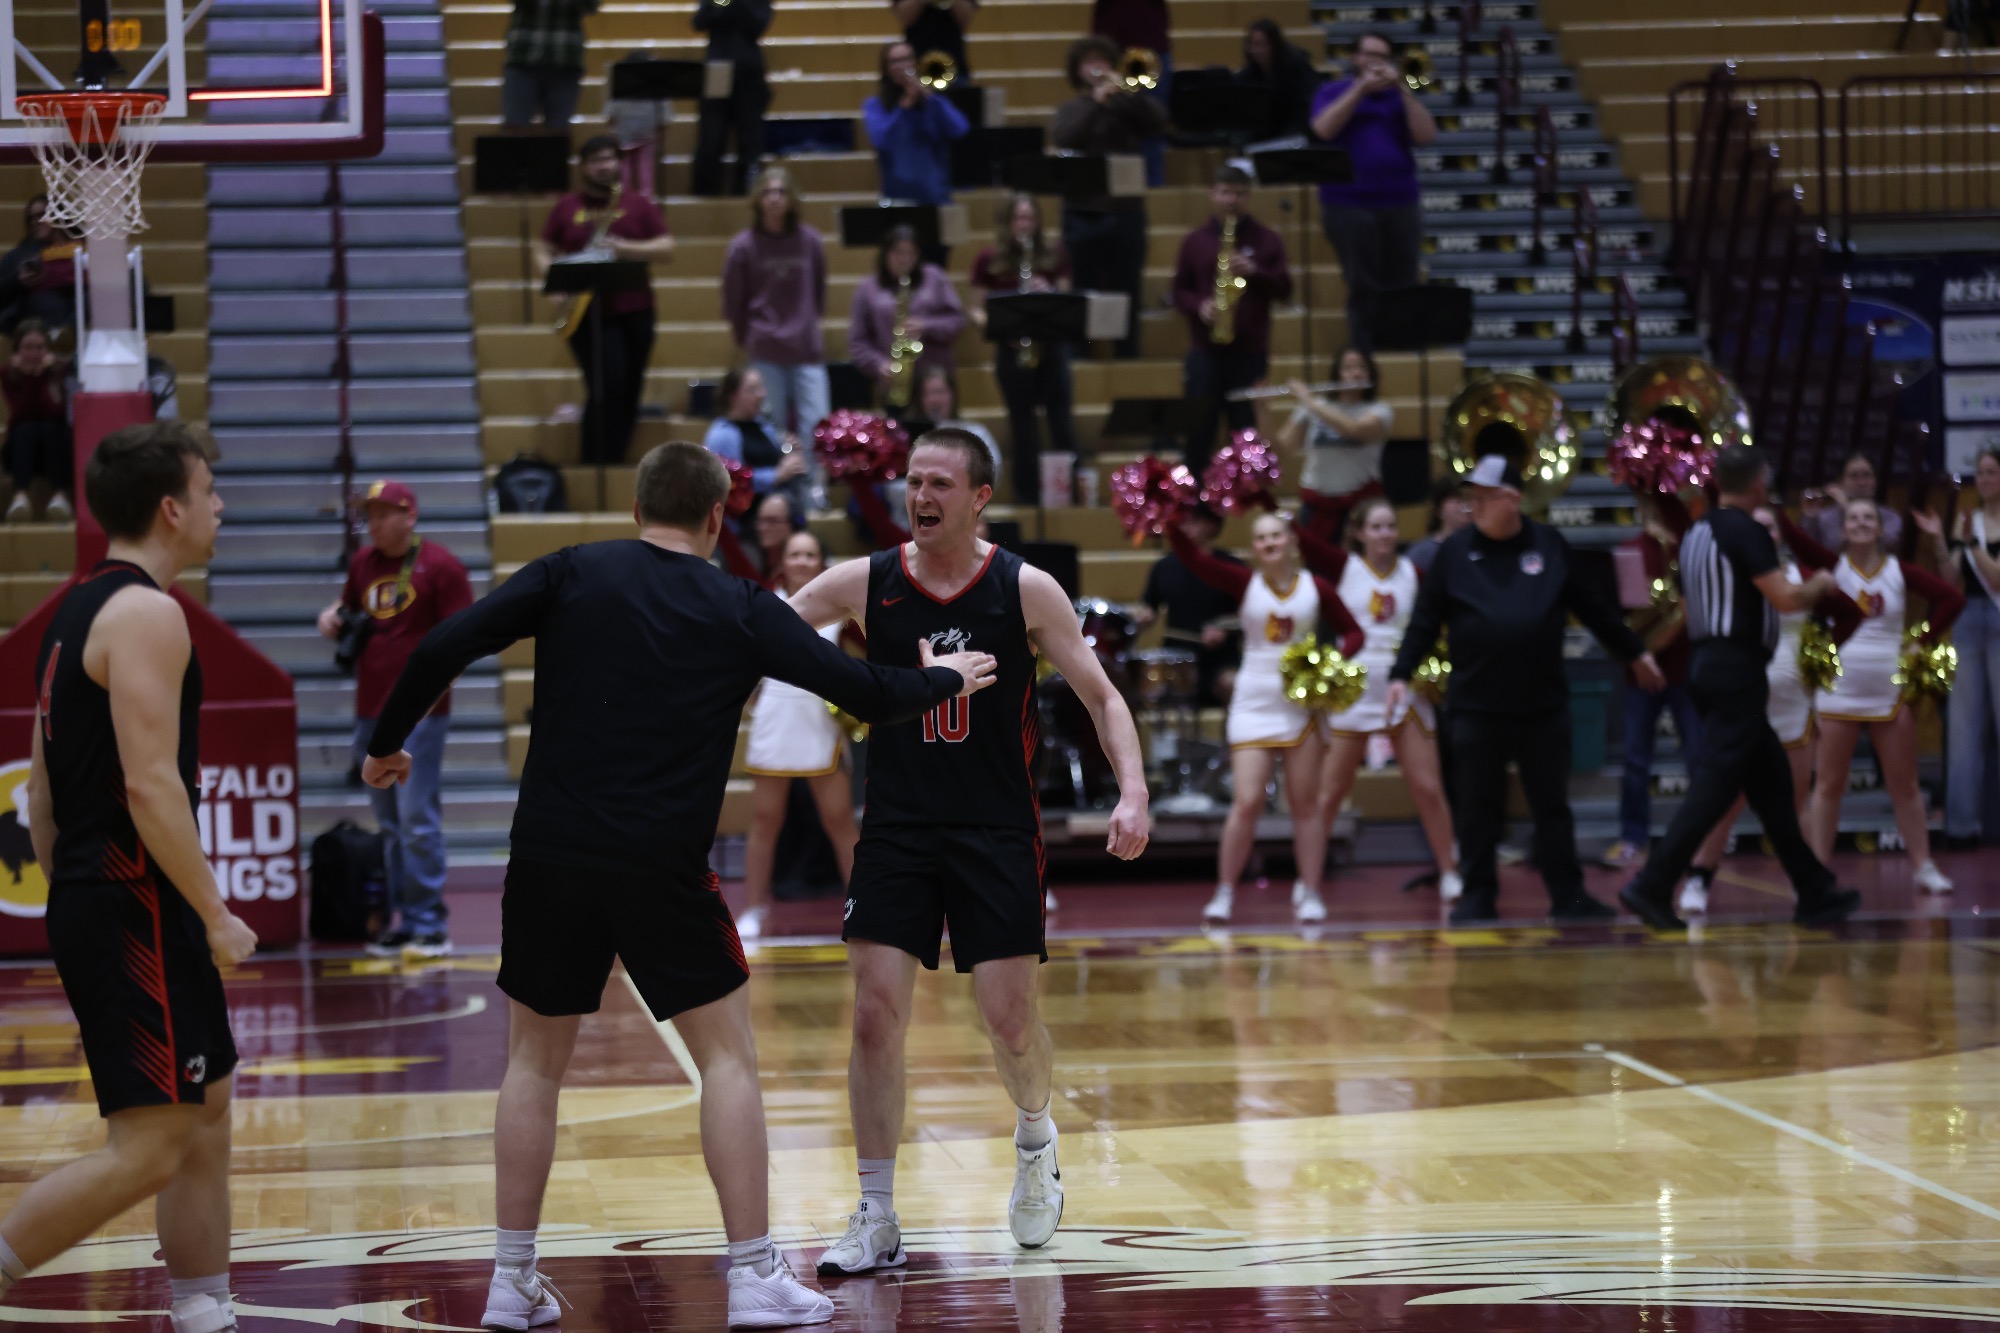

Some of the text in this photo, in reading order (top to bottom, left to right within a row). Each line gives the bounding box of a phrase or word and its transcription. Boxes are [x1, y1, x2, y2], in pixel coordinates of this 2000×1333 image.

[200, 764, 295, 799] FALO
[197, 800, 297, 856] ILD
[207, 857, 299, 903] NGS
